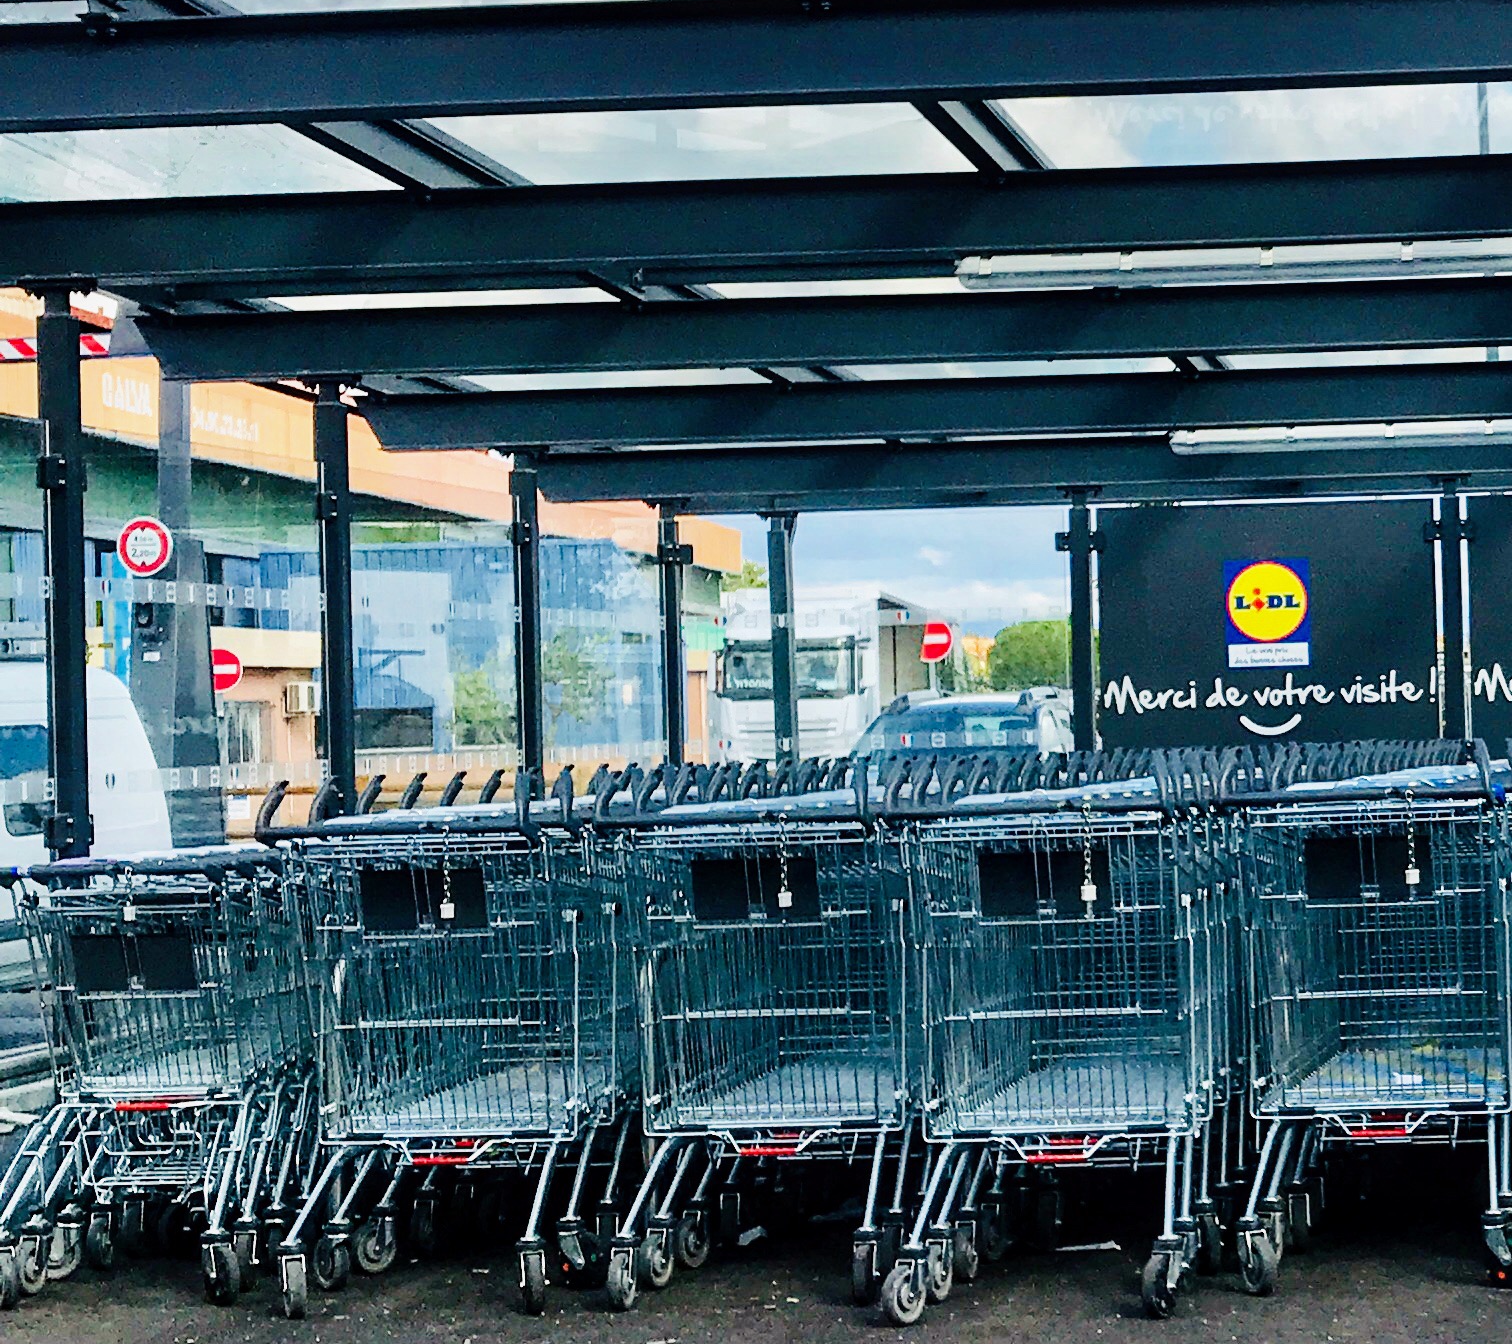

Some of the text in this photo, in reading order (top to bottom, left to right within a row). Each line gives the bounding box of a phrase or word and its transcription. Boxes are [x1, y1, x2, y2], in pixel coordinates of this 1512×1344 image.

[1103, 675, 1197, 714] Merci
[1205, 677, 1248, 707] de
[1253, 672, 1335, 706] votre
